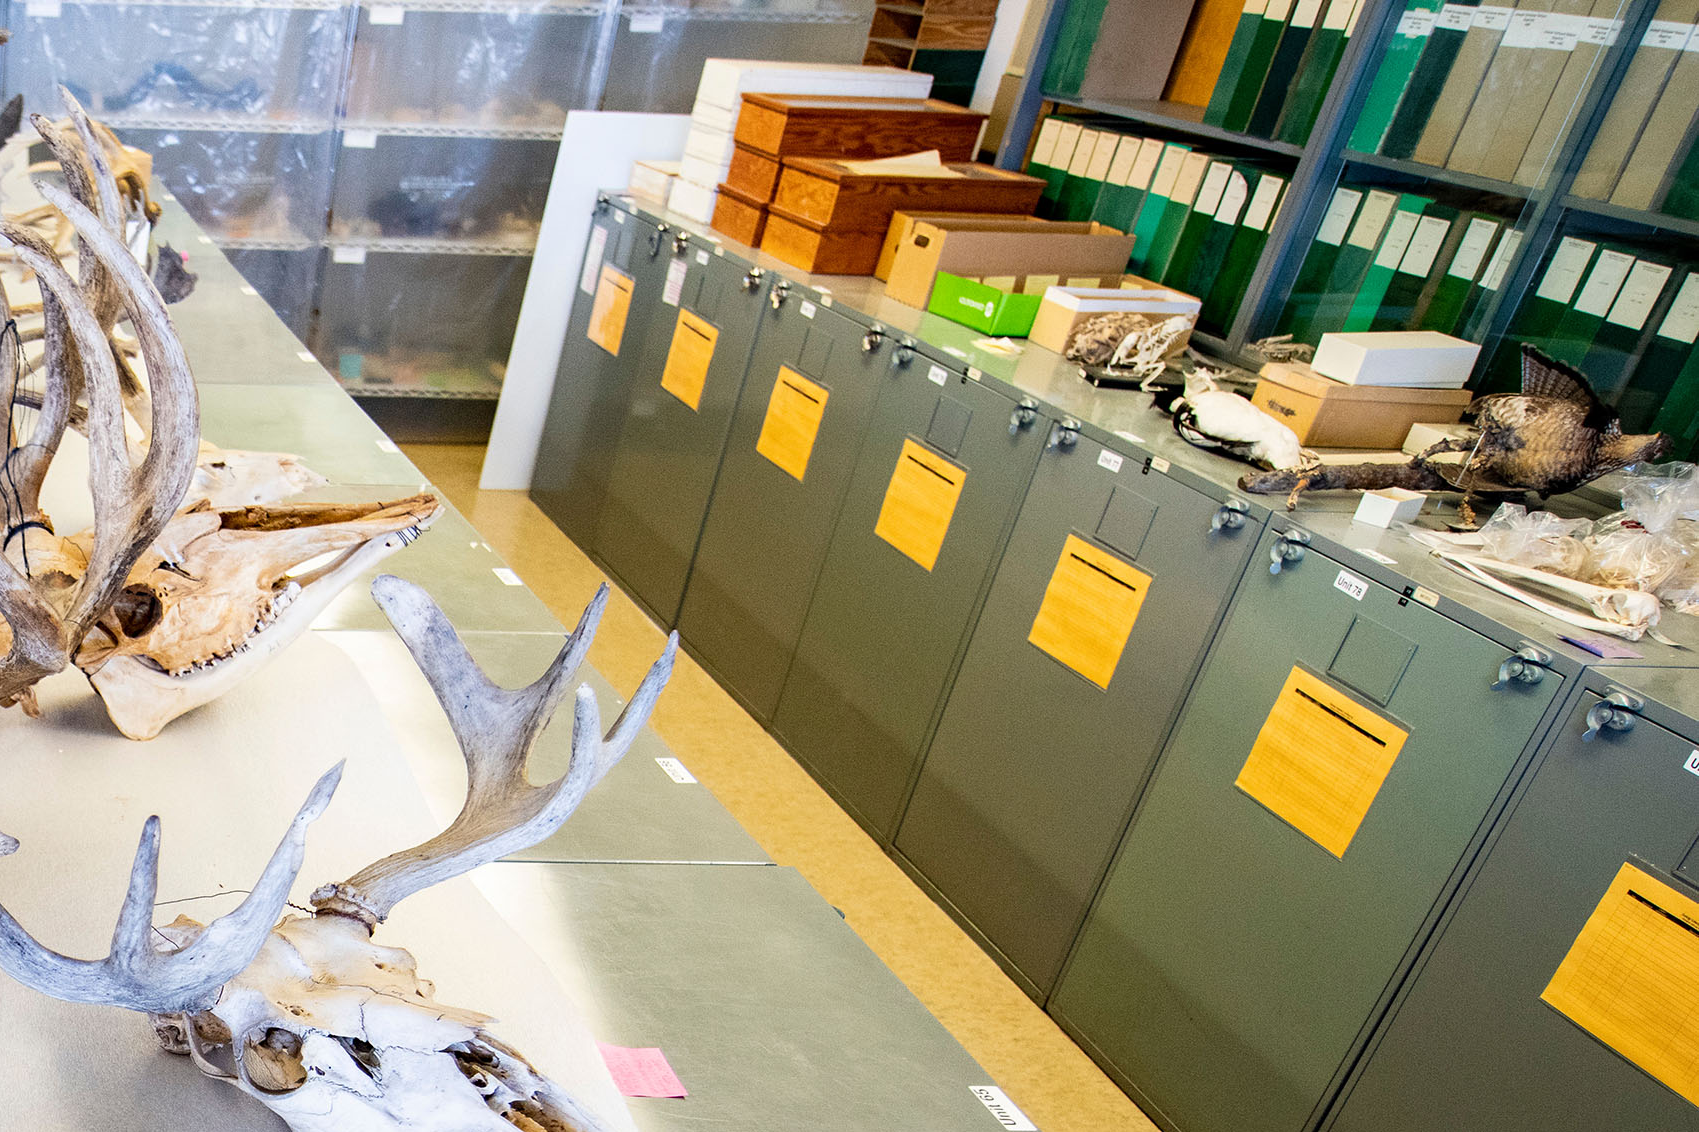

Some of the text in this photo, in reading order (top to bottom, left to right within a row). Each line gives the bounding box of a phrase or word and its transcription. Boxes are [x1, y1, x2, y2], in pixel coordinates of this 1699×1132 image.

[1337, 576, 1353, 591] Unit
[973, 1088, 1017, 1126] Unit 65
